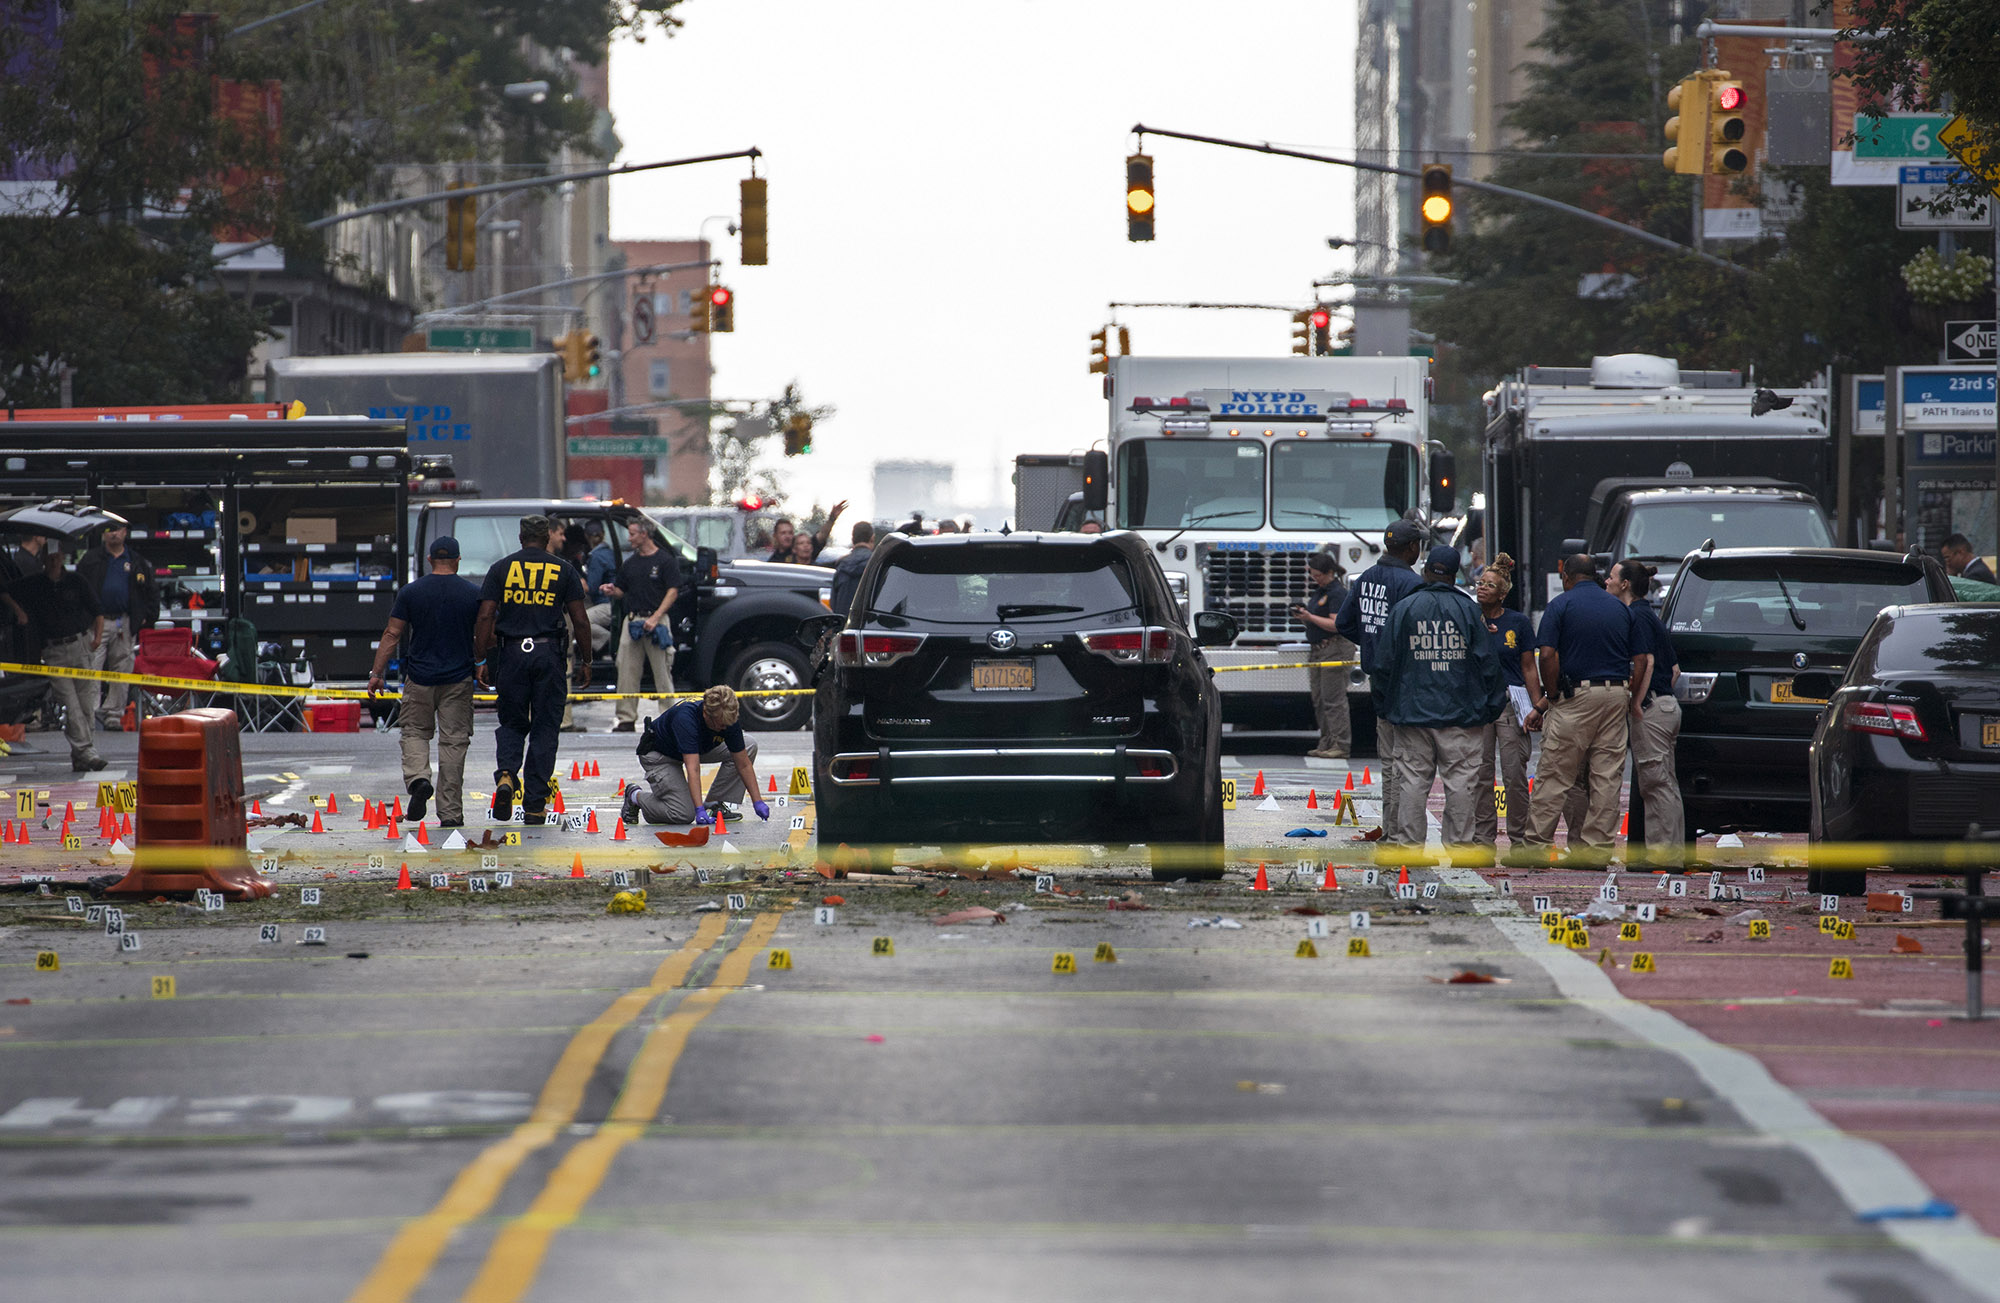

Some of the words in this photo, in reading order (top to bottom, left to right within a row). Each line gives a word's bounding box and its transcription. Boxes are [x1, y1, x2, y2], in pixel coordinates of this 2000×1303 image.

[1912, 124, 1931, 151] 6
[1965, 333, 1997, 349] ONE
[1950, 377, 1983, 390] 23rd
[1231, 391, 1307, 403] NYPD
[1220, 403, 1319, 415] POLICE
[1922, 407, 1948, 416] PATH
[1951, 407, 1979, 416] Trains
[1983, 408, 1994, 416] to
[1216, 542, 1260, 551] BOMB
[1265, 542, 1316, 552] SQUAD
[505, 561, 561, 590] ATF
[504, 589, 556, 606] POLICE
[1416, 620, 1459, 635] N.Y.C.
[1410, 634, 1468, 650] POLICE
[1414, 650, 1440, 660] CRIME
[1442, 650, 1466, 660] SCENE
[1431, 661, 1450, 671] UNIT
[876, 717, 931, 725] HIGHLANDER
[797, 768, 810, 788] 81
[102, 784, 115, 805] 79
[119, 787, 135, 809] 70
[19, 791, 32, 812] 71
[779, 796, 786, 807] 6
[547, 813, 558, 824] 14
[572, 816, 582, 827] 15
[793, 817, 804, 828] 17
[69, 838, 81, 849] 12
[510, 833, 518, 845] 3
[263, 859, 276, 871] 37
[370, 856, 383, 869] 39
[483, 856, 496, 868] 38
[1299, 860, 1312, 873] 17
[496, 873, 510, 886] 97
[614, 871, 627, 885] 81
[1366, 871, 1375, 884] 9
[1750, 869, 1764, 881] 14
[432, 875, 446, 889] 83
[471, 878, 486, 891] 84
[1503, 880, 1510, 893] 4
[1674, 882, 1682, 895] 8
[303, 889, 318, 903] 85
[1402, 884, 1414, 897] 17
[1425, 885, 1437, 897] 18
[1602, 886, 1617, 900] 16
[69, 898, 81, 911] 75
[208, 896, 222, 909] 76
[729, 896, 744, 909] 70
[1535, 897, 1548, 910] 77
[1823, 896, 1837, 910] 13
[1903, 897, 1911, 910] 5
[88, 907, 101, 921] 72
[107, 910, 121, 921] 73
[820, 909, 828, 923] 3
[1641, 907, 1649, 919] 4
[1356, 913, 1364, 927] 2
[1543, 913, 1559, 927] 45
[1822, 917, 1838, 931] 42
[107, 921, 121, 935] 64
[261, 926, 276, 940] 63
[1314, 920, 1321, 934] 1
[1622, 924, 1637, 938] 48
[1753, 921, 1768, 936] 38
[1836, 923, 1849, 937] 43
[122, 934, 137, 948] 61
[1550, 928, 1566, 941] 47
[1572, 931, 1588, 946] 49
[770, 951, 785, 967] 21
[1055, 955, 1071, 970] 22
[154, 979, 170, 994] 31
